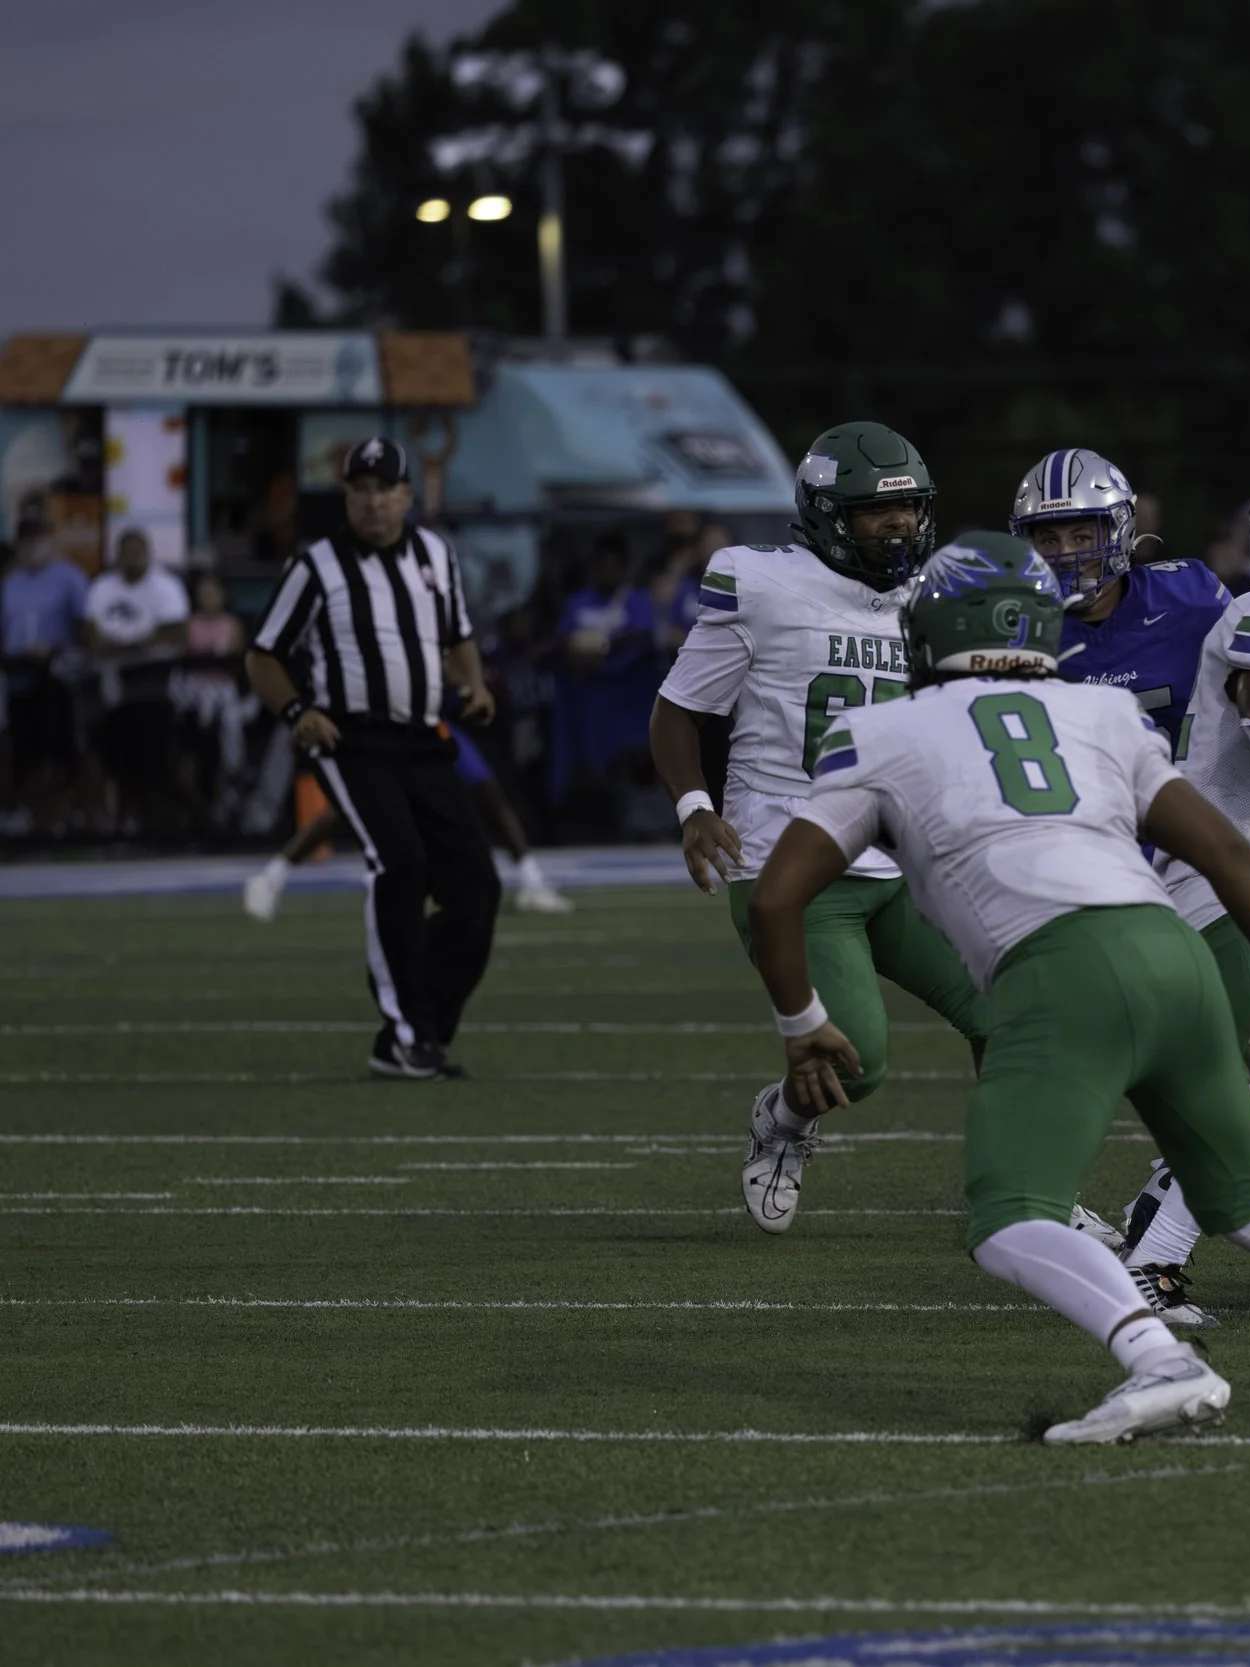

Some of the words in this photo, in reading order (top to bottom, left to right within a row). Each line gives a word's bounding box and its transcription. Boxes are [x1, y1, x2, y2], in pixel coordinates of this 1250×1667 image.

[162, 349, 280, 384] TOM'S
[881, 477, 913, 489] Riddell
[1040, 500, 1072, 511] Riddell
[968, 692, 1080, 816] 8
